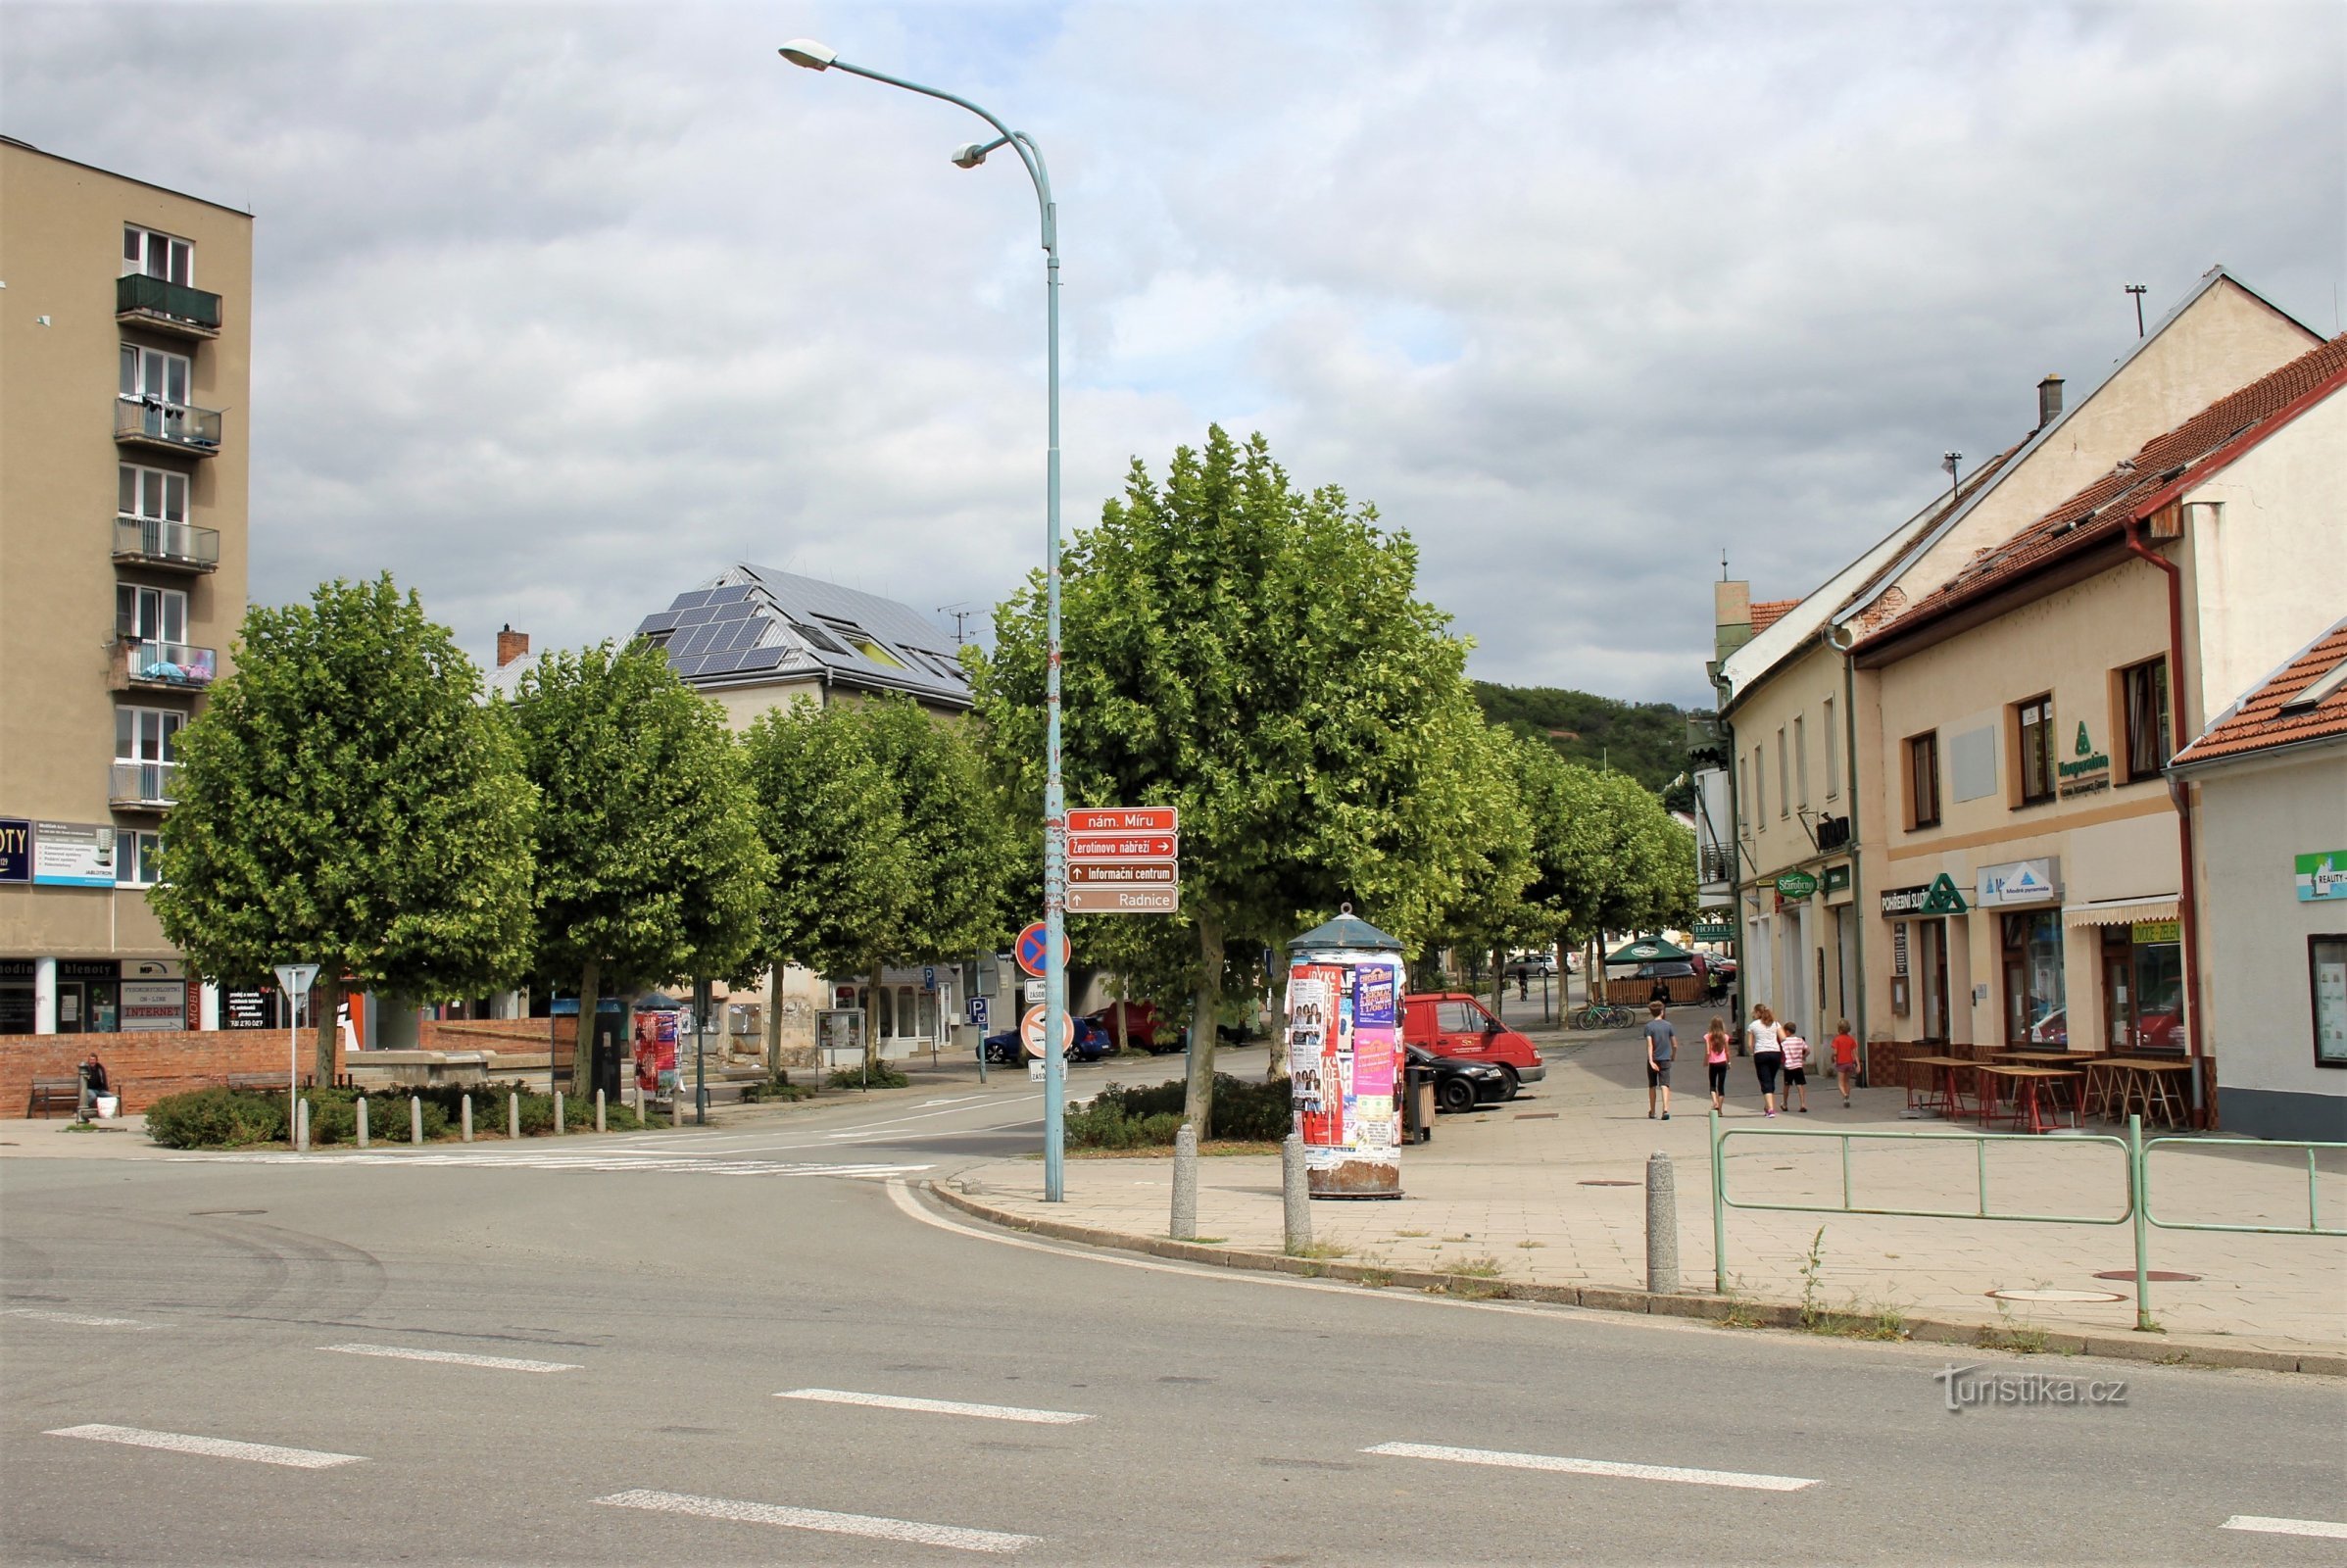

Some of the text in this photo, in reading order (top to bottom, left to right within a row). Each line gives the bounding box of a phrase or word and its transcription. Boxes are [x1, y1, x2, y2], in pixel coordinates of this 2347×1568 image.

[2058, 756, 2108, 777] Kooperativa
[1088, 813, 1153, 827] nám. Míru
[1073, 838, 1150, 854] Žerotínovo nábřeží
[1088, 866, 1170, 880] Informační centrum
[2319, 873, 2343, 884] REALITY
[2025, 885, 2050, 894] pyramida
[1119, 893, 1170, 906] Radnice
[1882, 891, 1911, 911] POHŘEBNÍ
[1695, 924, 1730, 933] HOTEL
[65, 963, 111, 975] klenoty
[926, 969, 932, 983] P
[124, 1006, 181, 1017] INTERNET
[973, 1001, 983, 1016] P
